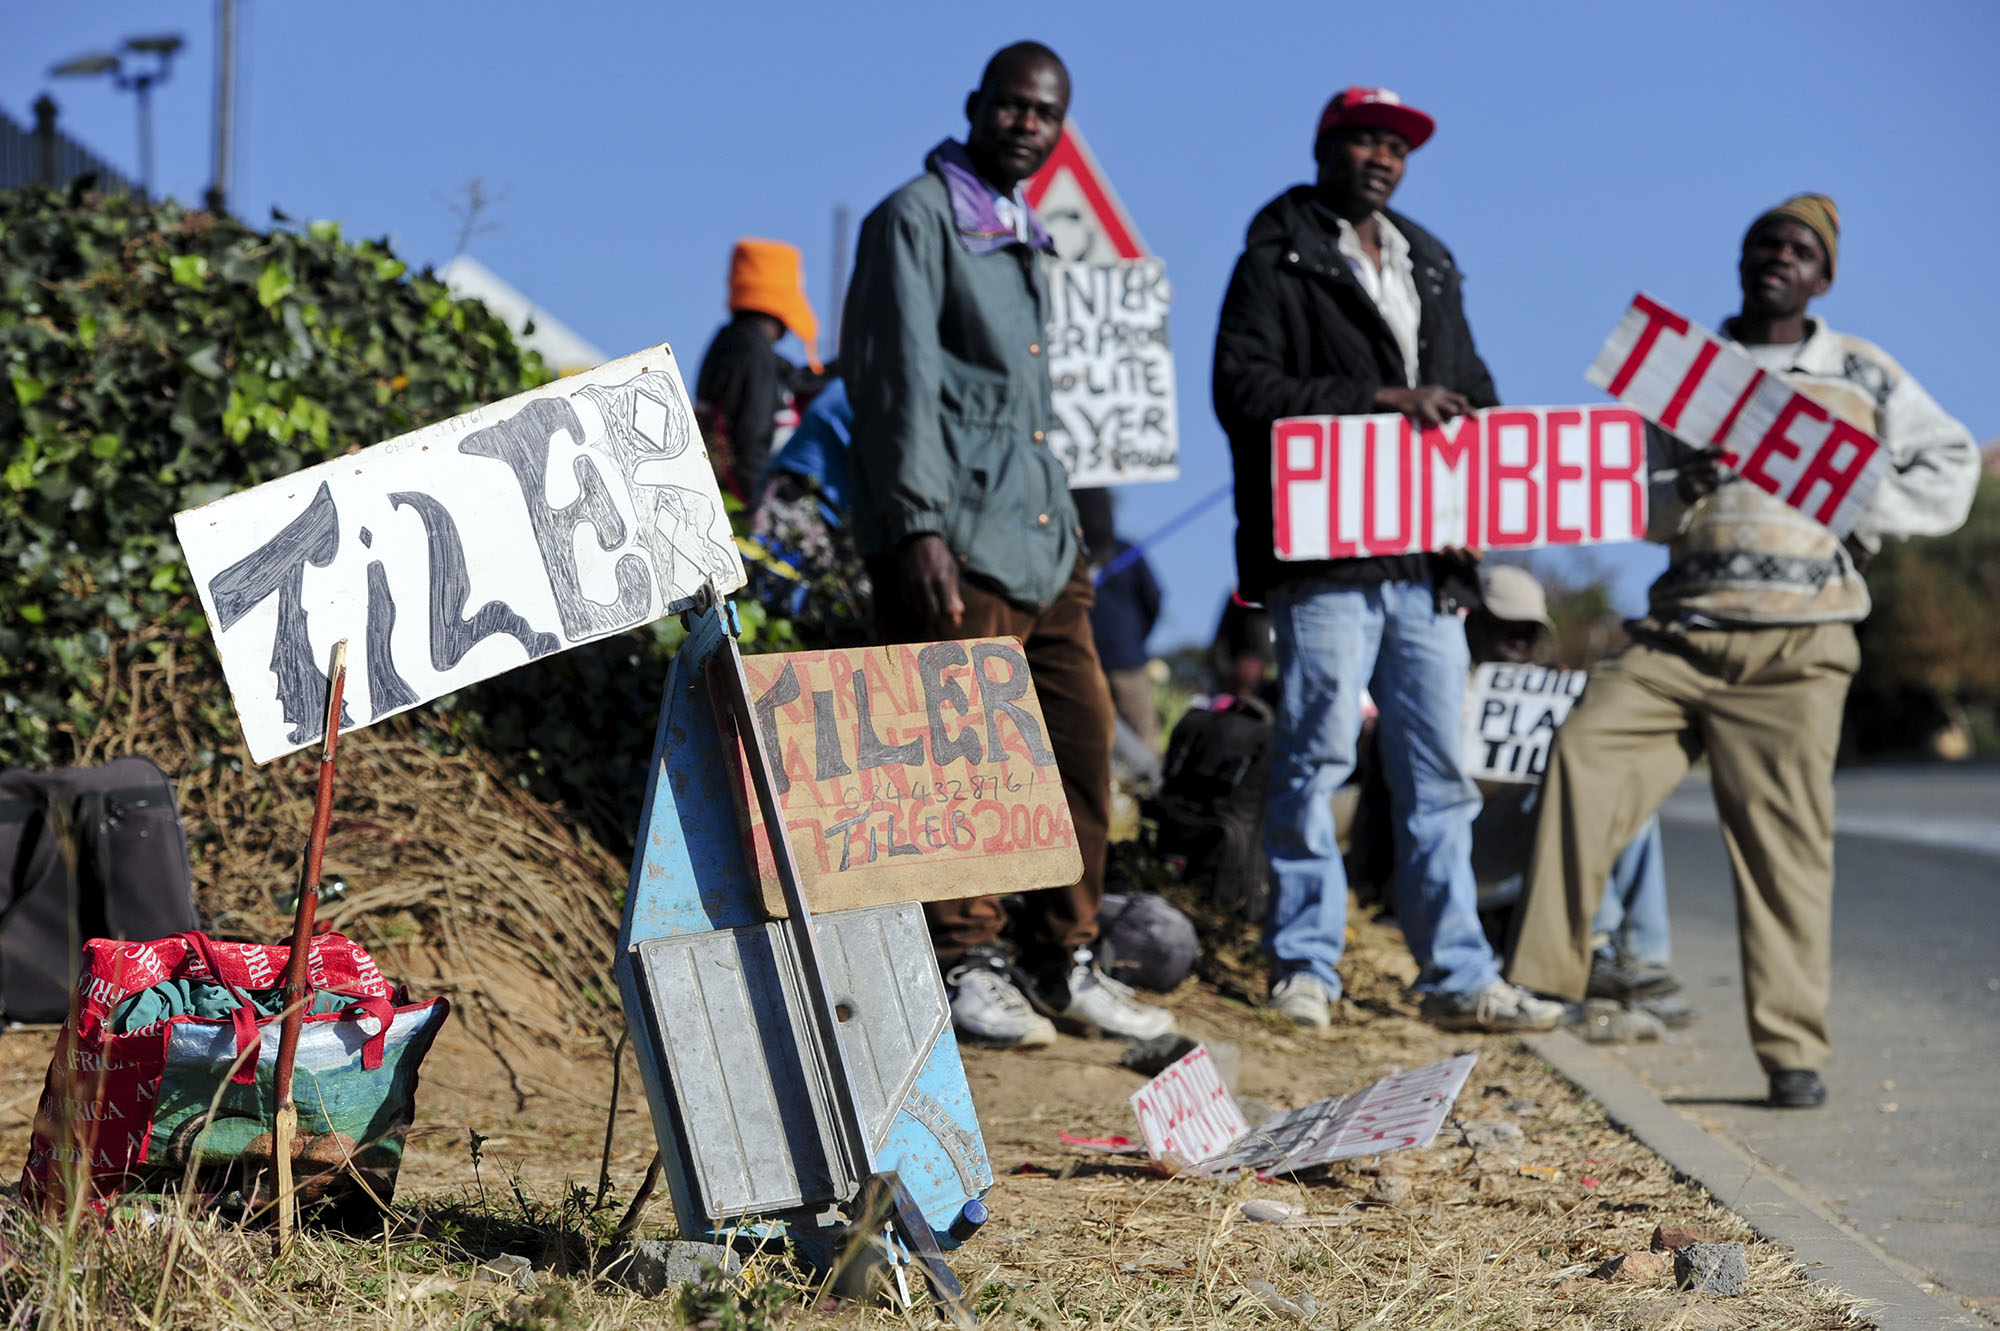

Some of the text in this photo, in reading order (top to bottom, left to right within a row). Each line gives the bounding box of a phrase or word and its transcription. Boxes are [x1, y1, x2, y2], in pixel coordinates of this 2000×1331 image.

[1274, 407, 1644, 559] PLUMBER
[1607, 292, 1879, 525] TILER
[754, 641, 1059, 796] TILER
[843, 772, 1034, 811] 0844328761
[824, 810, 976, 872] TILER
